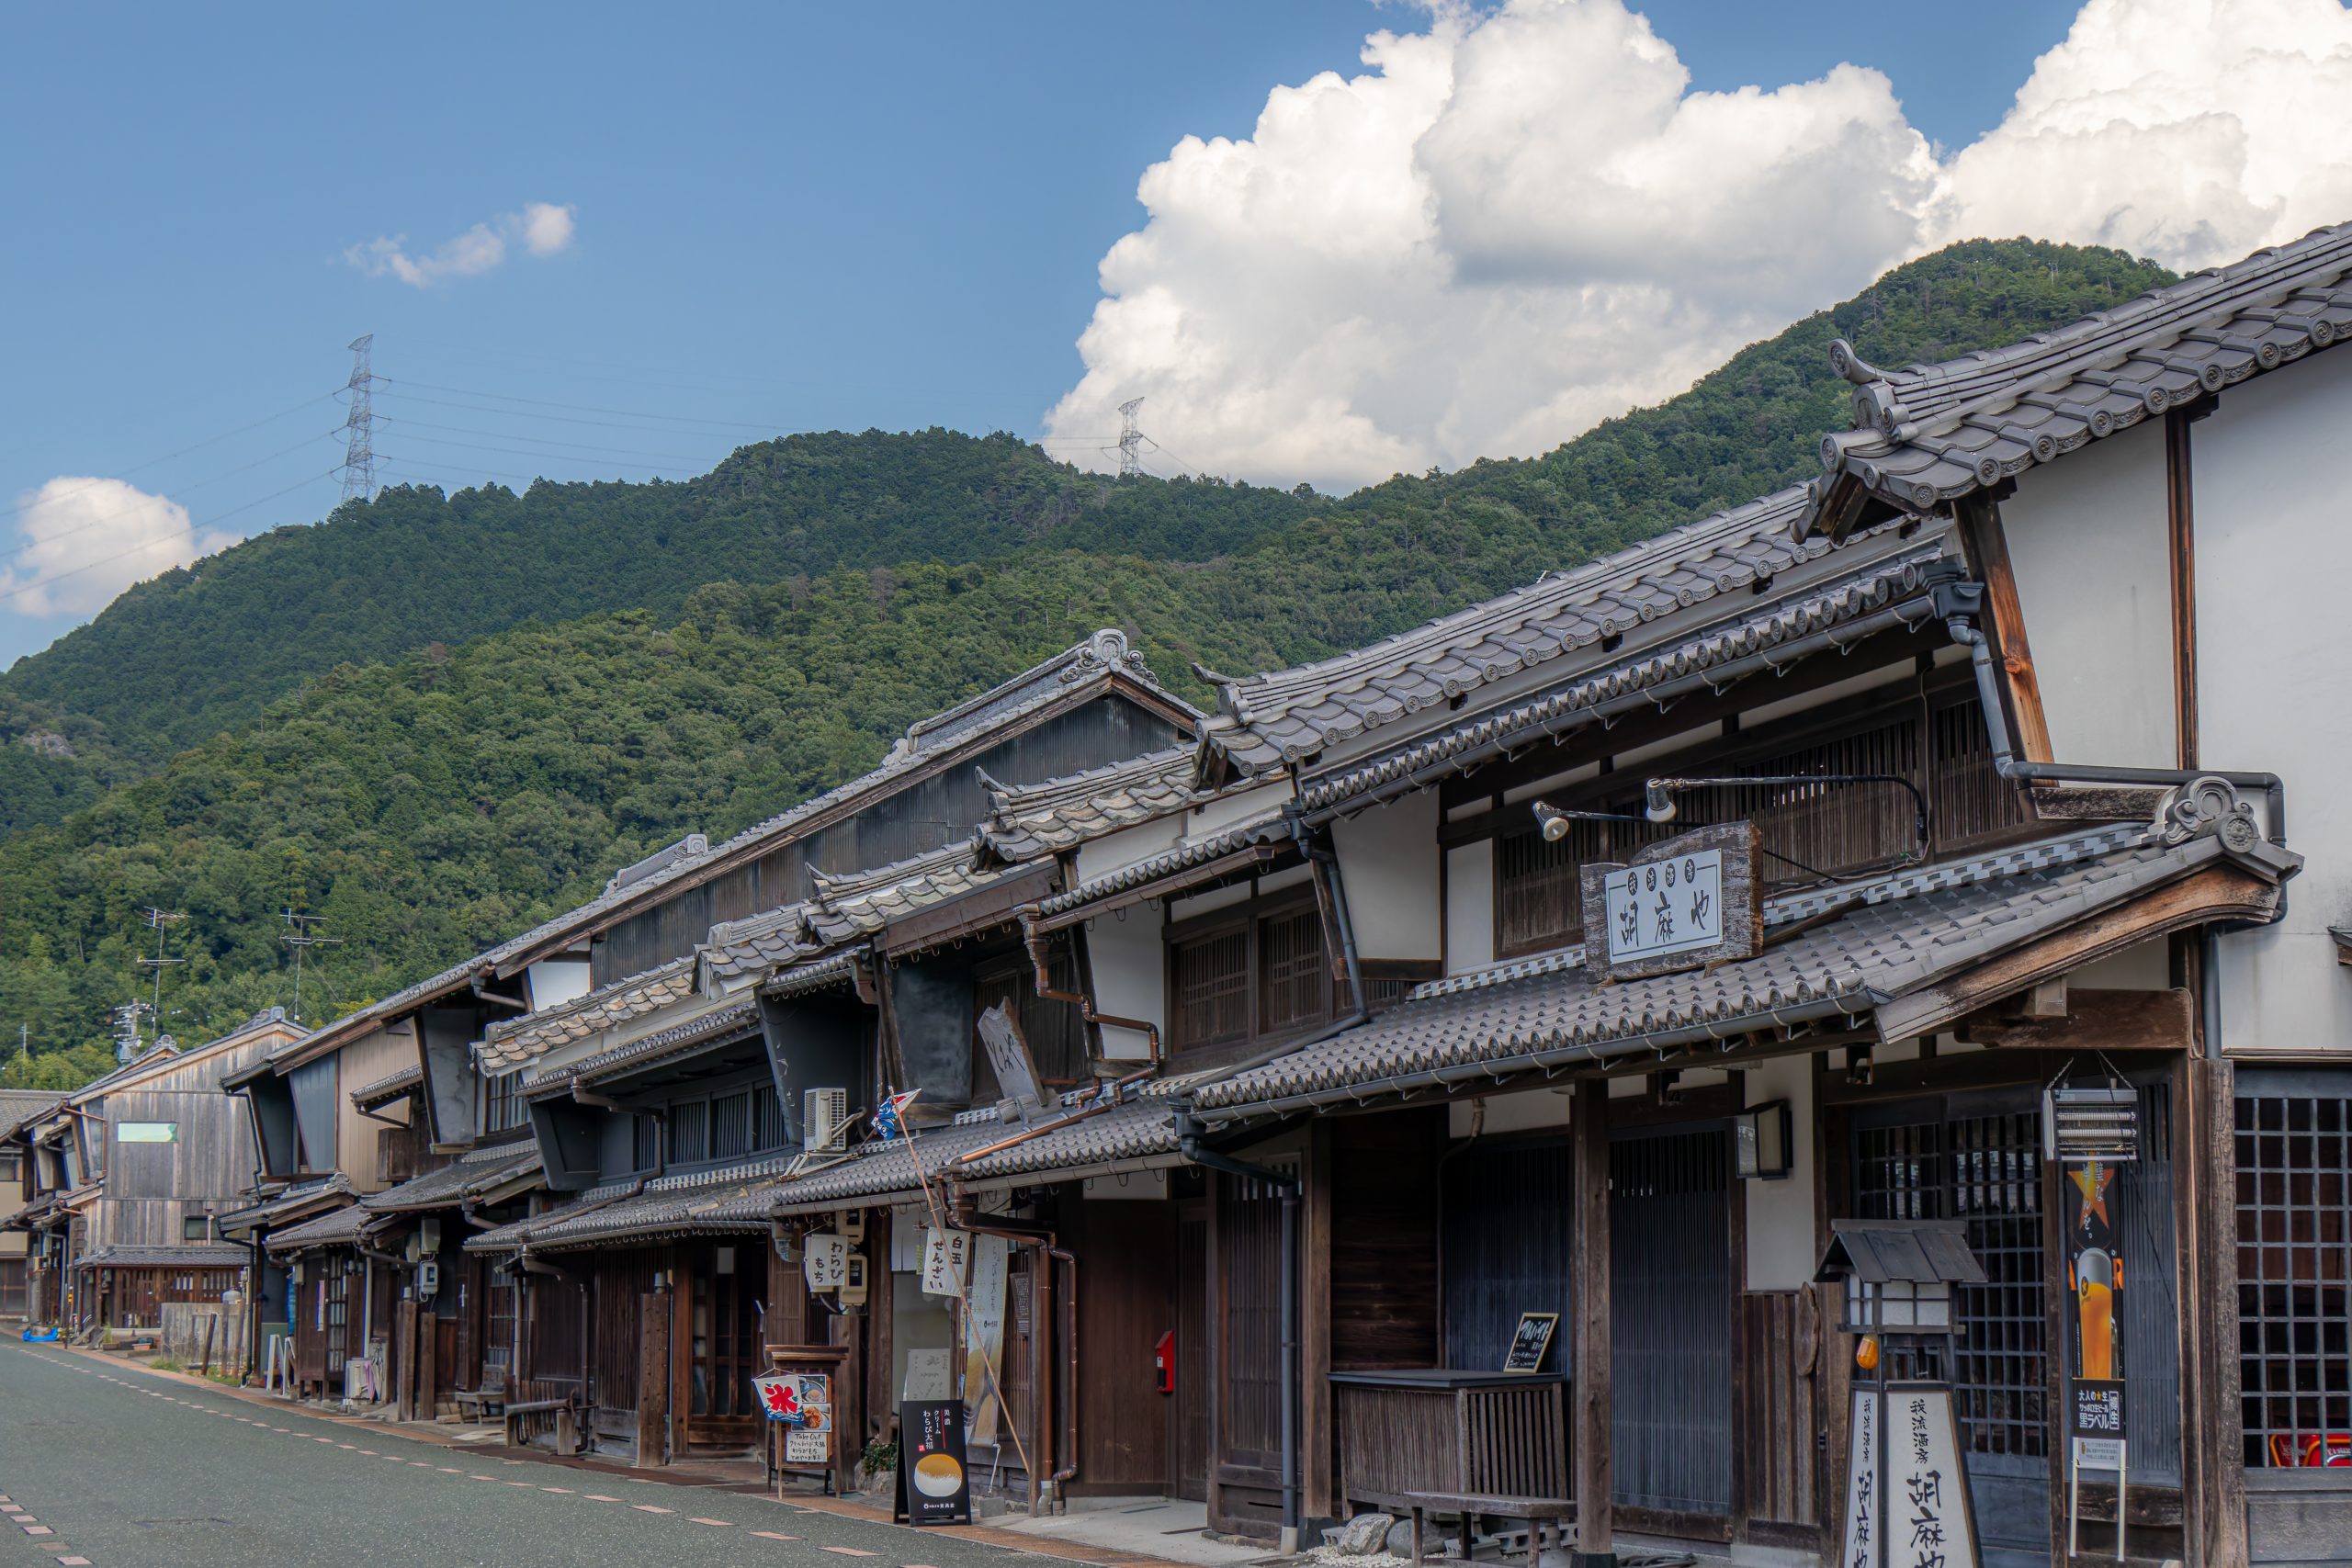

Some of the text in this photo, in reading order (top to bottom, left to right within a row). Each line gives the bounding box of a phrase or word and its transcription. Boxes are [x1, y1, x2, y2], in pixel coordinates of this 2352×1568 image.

[830, 1241, 844, 1280] わらび
[951, 1235, 963, 1265] 白玉
[814, 1257, 825, 1283] もち
[763, 1383, 798, 1415] 氷
[922, 1410, 934, 1450] わらび大福
[1909, 1398, 1929, 1464] 我流酒房
[2079, 1412, 2109, 1429] 黒ラベル
